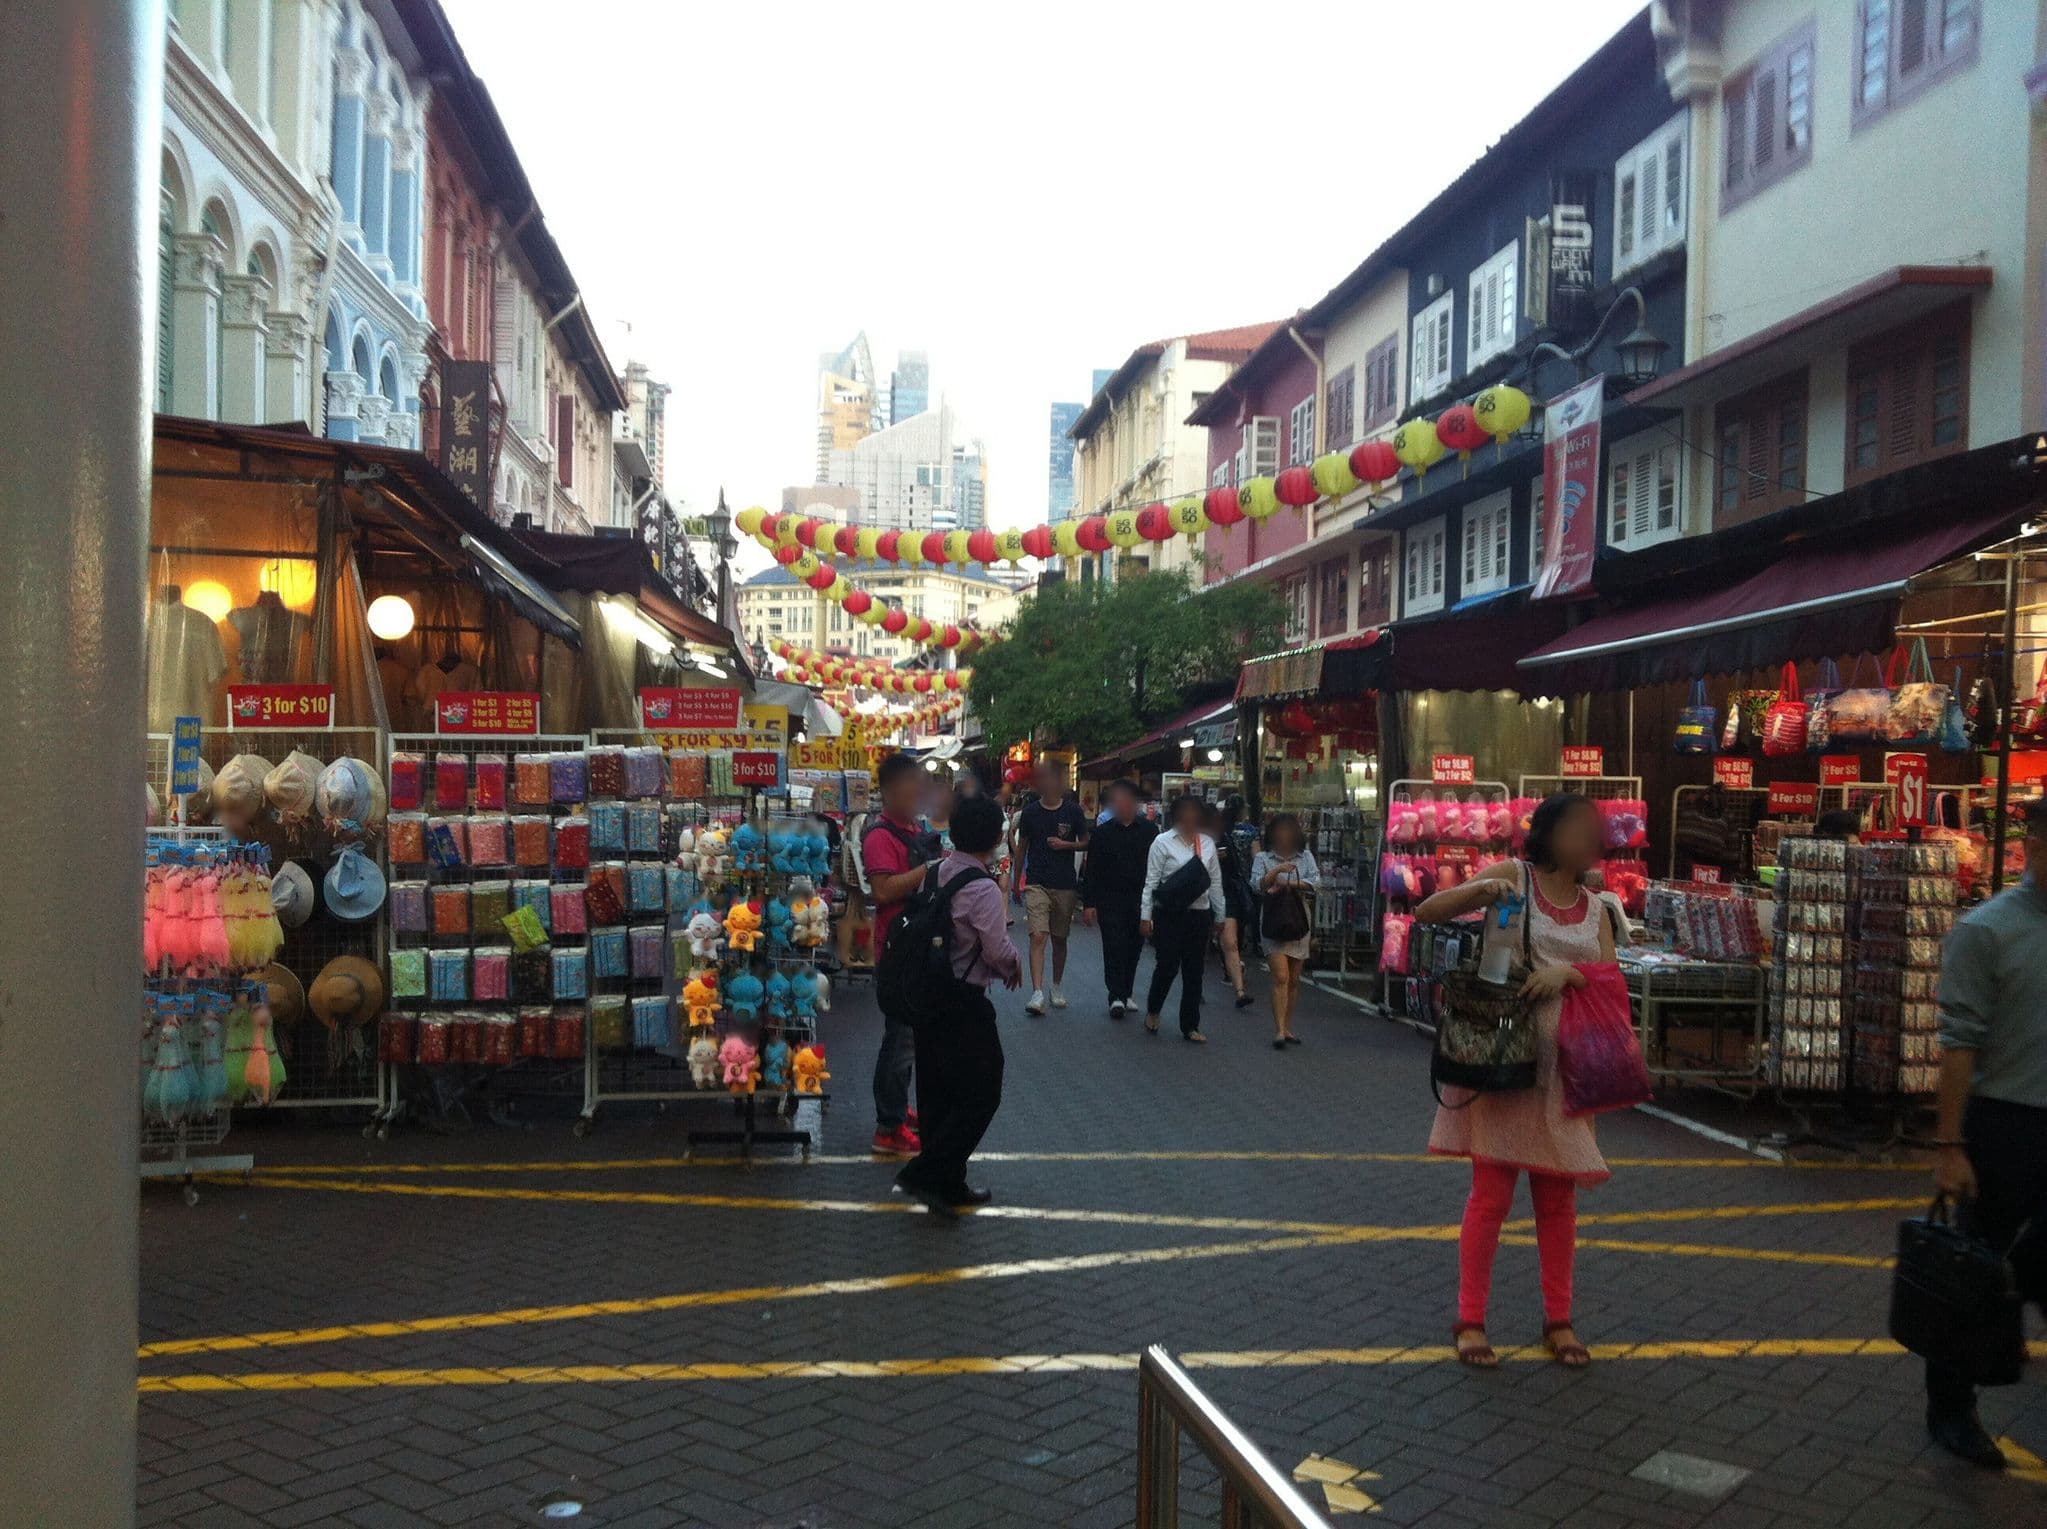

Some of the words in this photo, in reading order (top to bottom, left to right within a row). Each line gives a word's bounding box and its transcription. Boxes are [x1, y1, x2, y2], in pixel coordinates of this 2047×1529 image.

[1552, 204, 1592, 248] 5
[1182, 507, 1197, 515] SG
[1116, 519, 1131, 527] SG
[1182, 515, 1197, 524] 50
[1116, 526, 1131, 535] 50
[263, 696, 272, 714] 3
[275, 697, 297, 714] for
[300, 696, 328, 715] $10
[477, 698, 488, 706] for
[478, 719, 488, 728] for
[488, 720, 502, 728] $10
[848, 725, 856, 740] 5
[678, 734, 710, 746] FOR
[800, 746, 811, 763] 5
[815, 750, 833, 764] FOR
[842, 750, 860, 769] $10
[733, 763, 740, 776] 3
[741, 762, 755, 776] for
[758, 763, 776, 777] $10
[1772, 794, 1778, 802] 4
[1780, 794, 1794, 803] For
[1796, 794, 1812, 804] $10
[1902, 771, 1923, 823] $1
